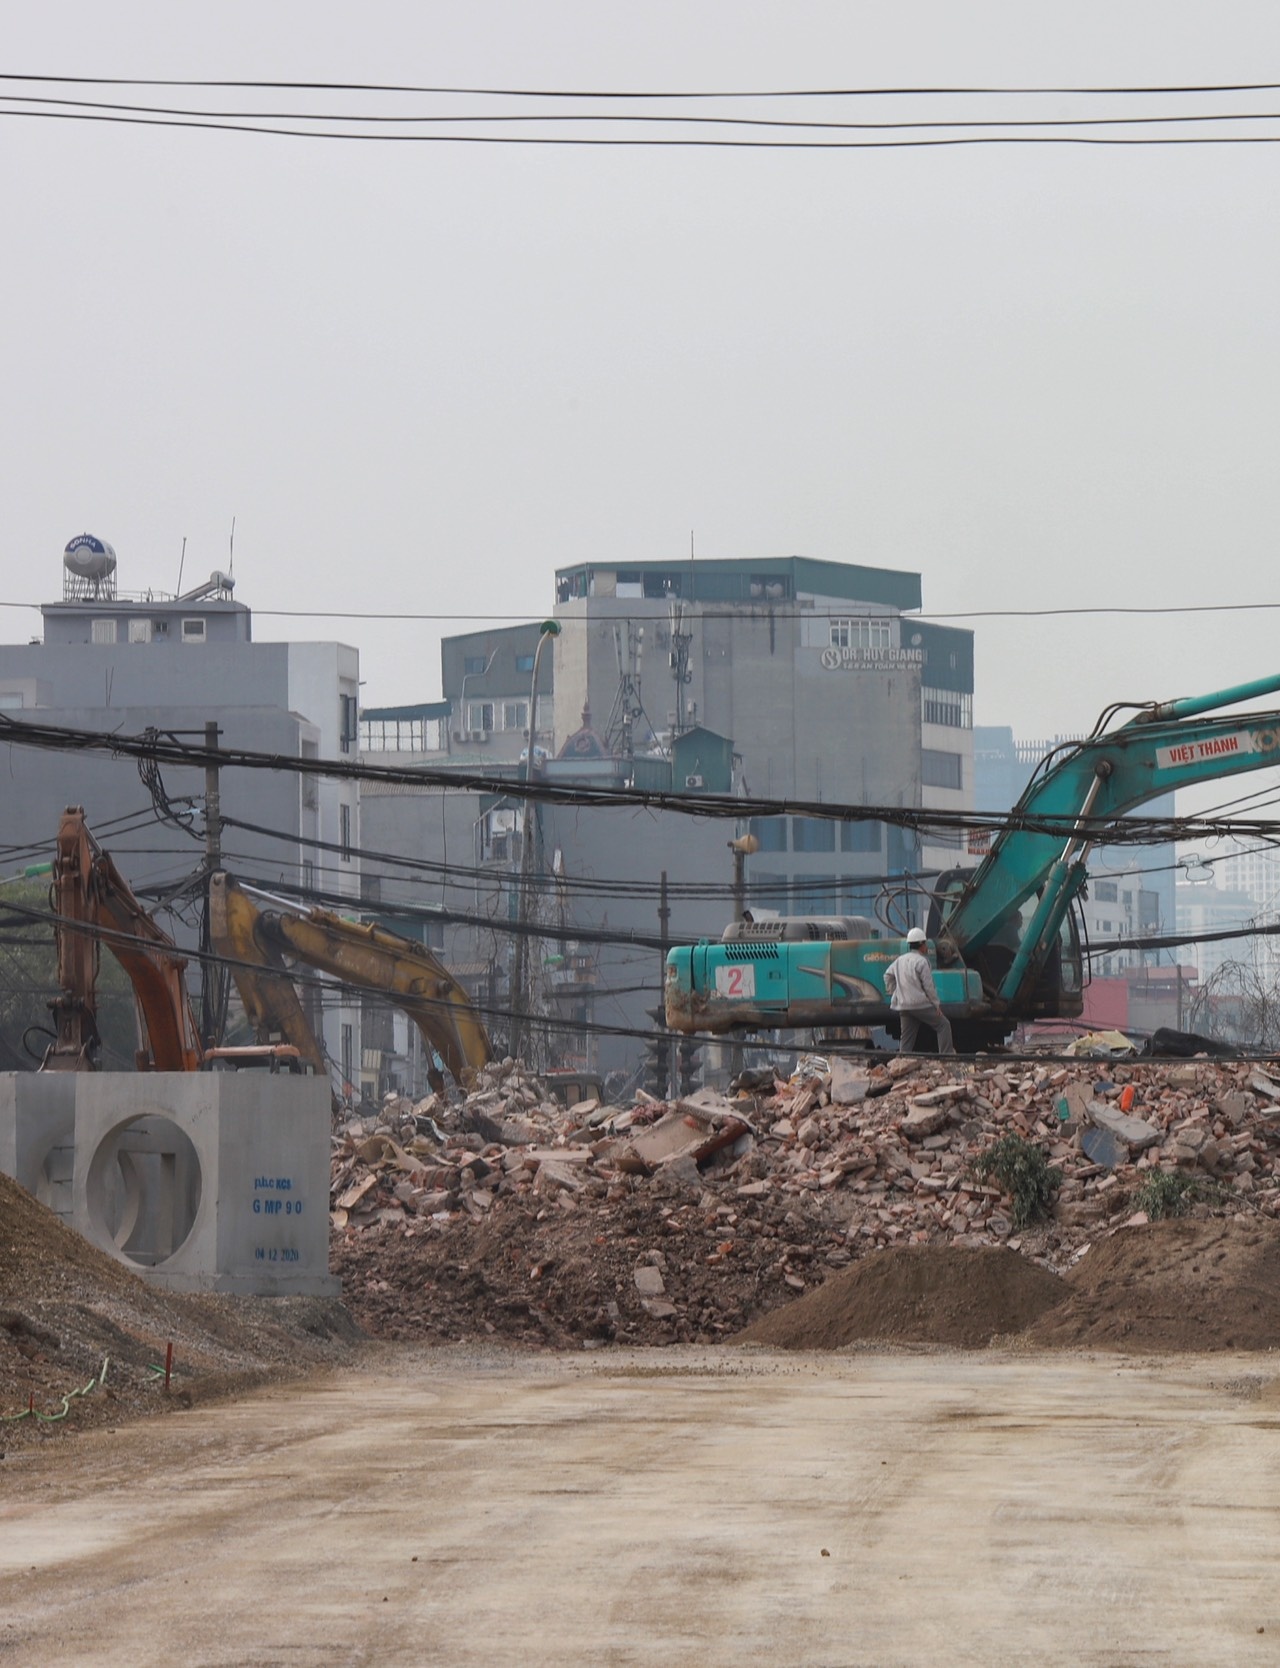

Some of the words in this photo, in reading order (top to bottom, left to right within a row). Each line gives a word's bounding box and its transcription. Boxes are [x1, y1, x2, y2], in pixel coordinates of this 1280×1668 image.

[863, 648, 886, 661] HUY
[889, 648, 923, 662] GIANG
[727, 967, 743, 995] 2
